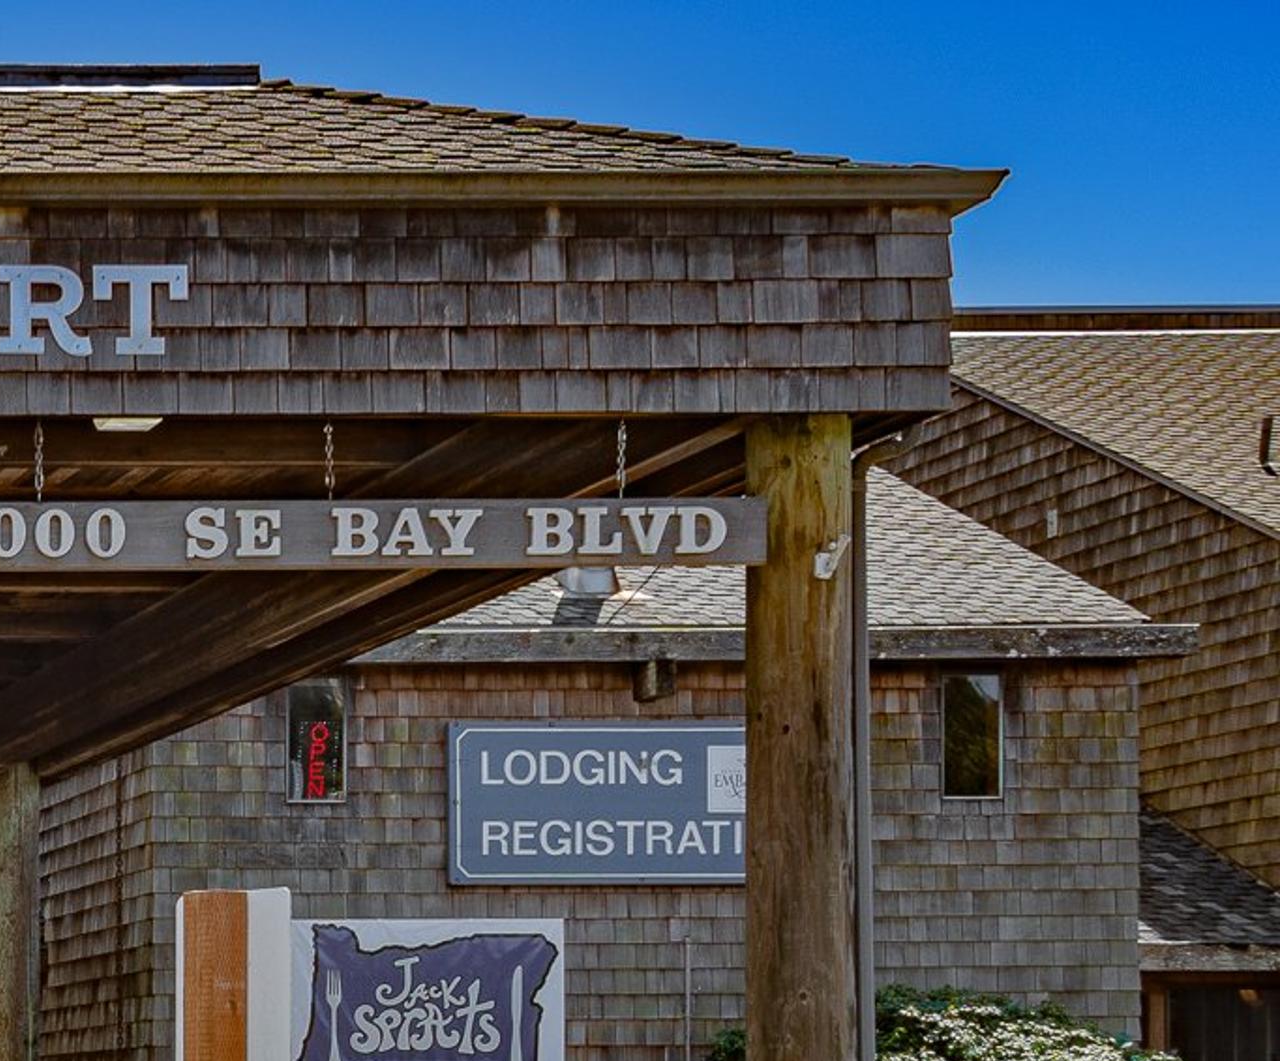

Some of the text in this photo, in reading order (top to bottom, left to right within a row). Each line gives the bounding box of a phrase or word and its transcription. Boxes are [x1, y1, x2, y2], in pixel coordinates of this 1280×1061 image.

[184, 506, 283, 559] SE
[329, 505, 485, 557] BAY
[524, 505, 728, 555] BLVD
[306, 722, 330, 800] OPEN
[480, 749, 684, 786] LODGING
[481, 820, 743, 856] REGISTRATI
